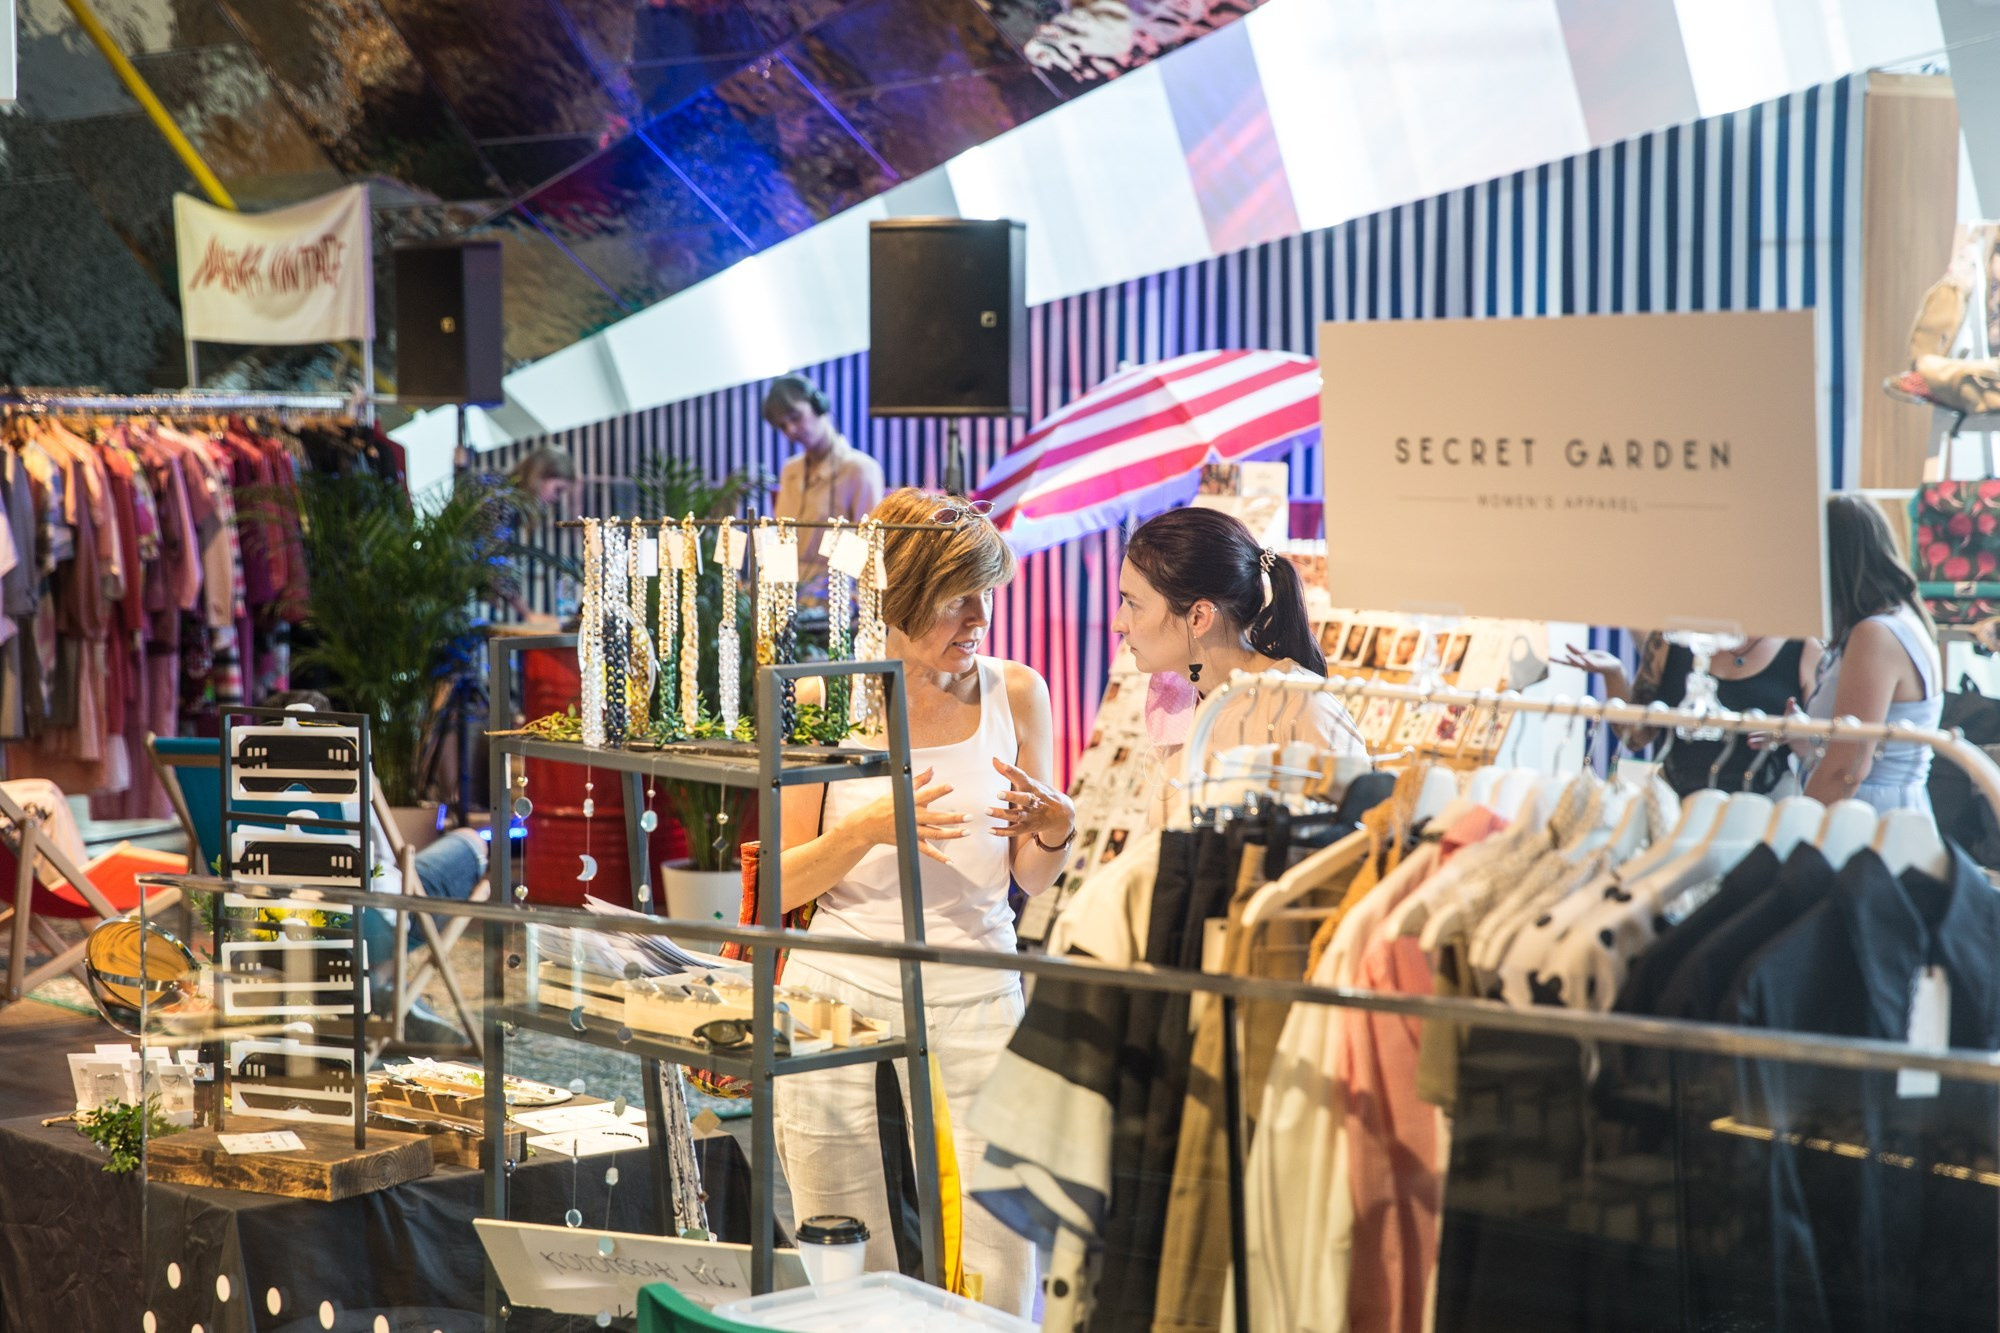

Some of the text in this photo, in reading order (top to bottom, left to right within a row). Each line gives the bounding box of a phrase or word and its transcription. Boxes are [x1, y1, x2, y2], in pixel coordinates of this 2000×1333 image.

[1395, 436, 1732, 470] SECRET GARDEN
[1476, 493, 1640, 514] WOMEN'S APPAREL
